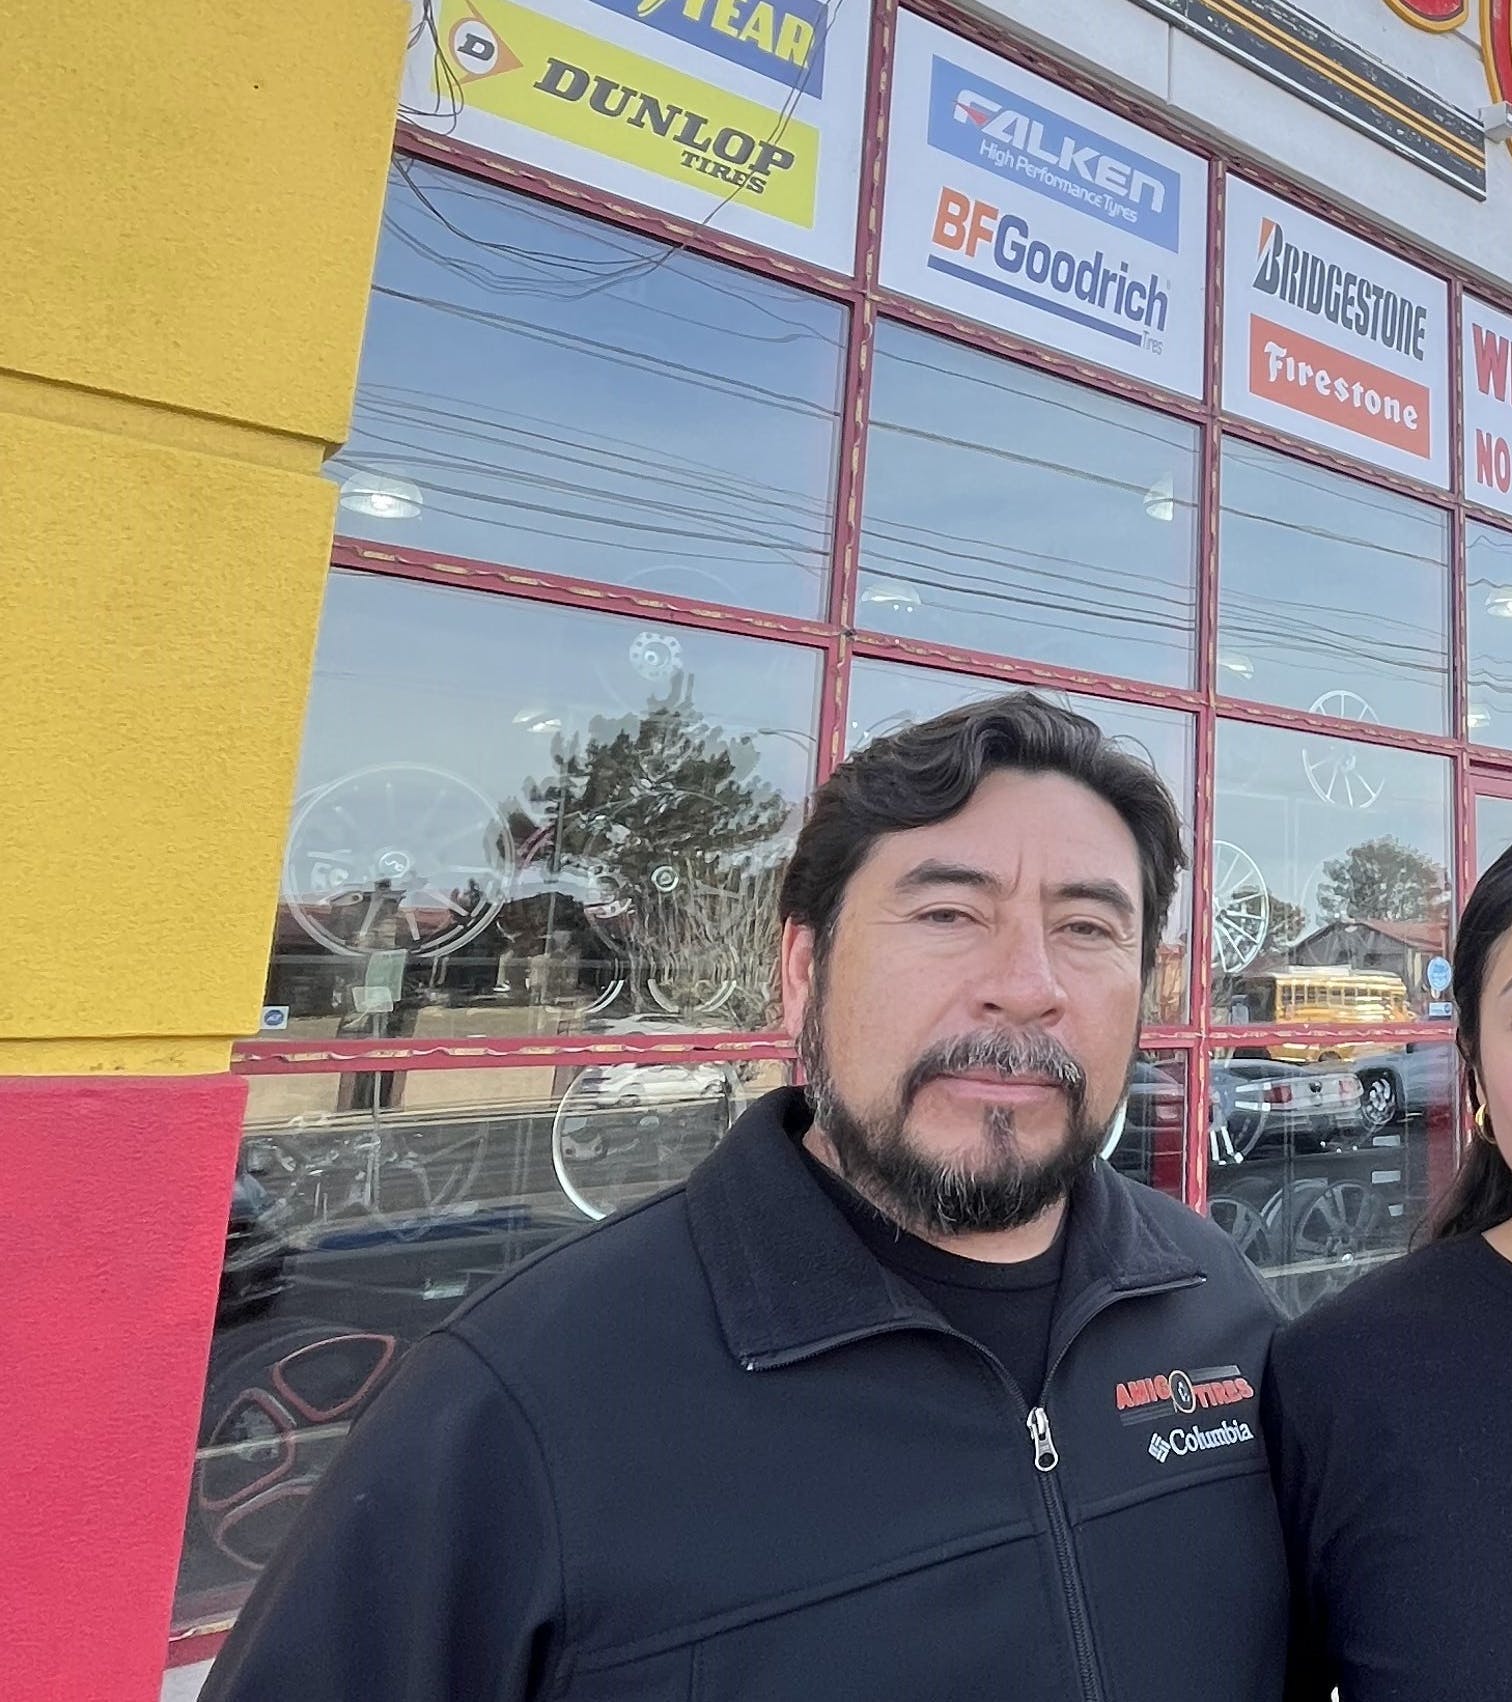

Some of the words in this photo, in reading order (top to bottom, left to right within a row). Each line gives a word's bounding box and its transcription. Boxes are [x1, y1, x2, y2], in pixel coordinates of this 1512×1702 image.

[533, 57, 795, 176] DUNLOP
[953, 88, 1166, 213] FALKEN
[681, 149, 767, 195] TIRES
[979, 138, 1014, 168] High
[1014, 157, 1102, 208] Performance
[932, 186, 1169, 332] BFGoodrich
[1252, 217, 1427, 361] BRIDGESTONE
[1141, 330, 1163, 355] Tires
[1264, 341, 1419, 430] Firestone
[1476, 429, 1512, 494] NO
[1192, 1377, 1255, 1408] TIRES
[1168, 1419, 1255, 1456] Columbia
